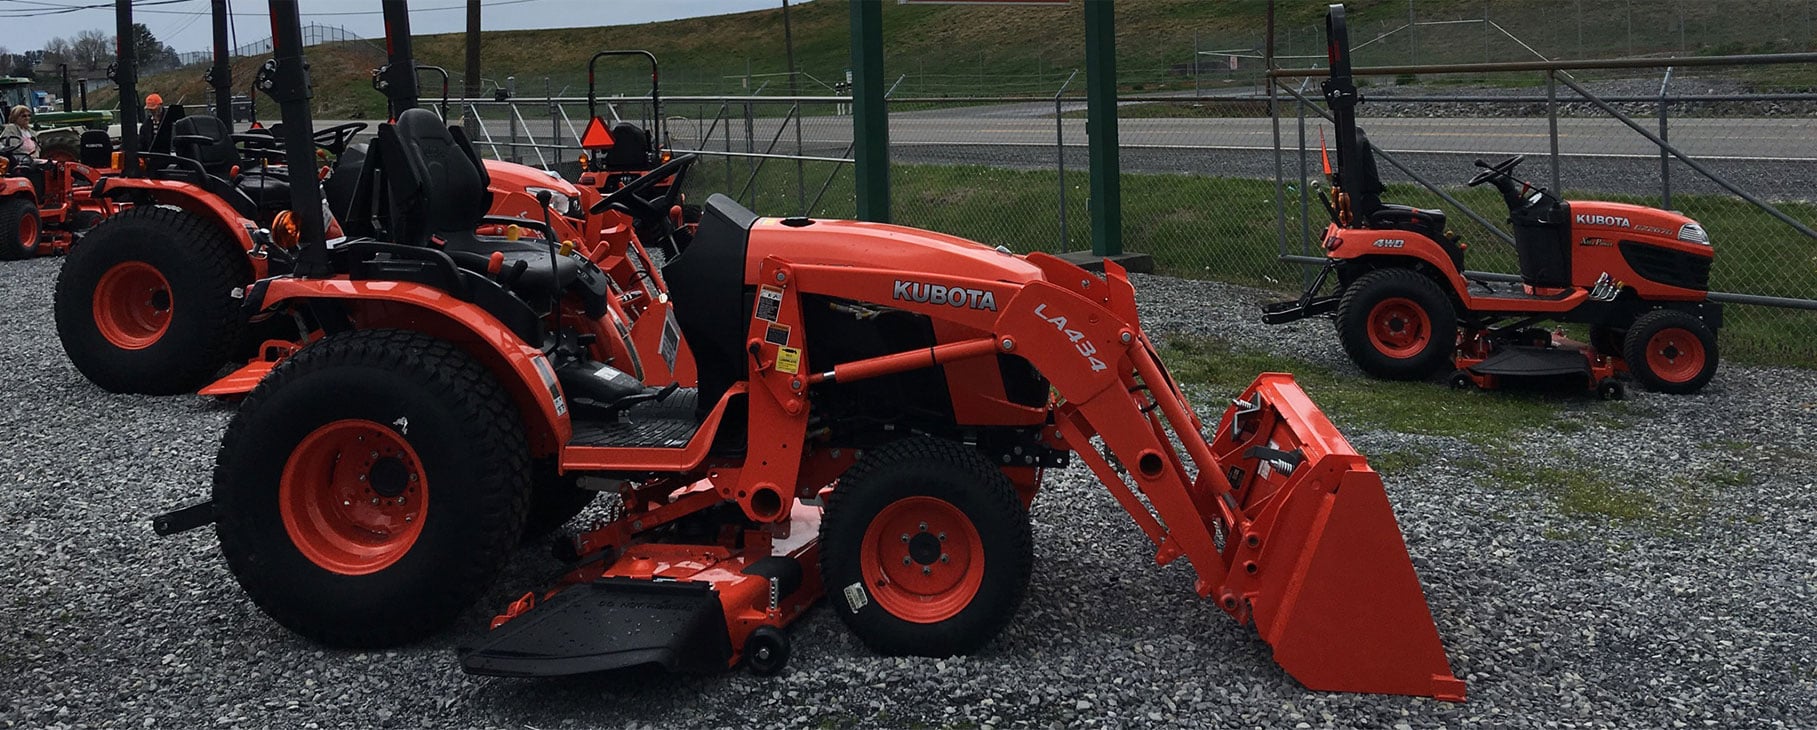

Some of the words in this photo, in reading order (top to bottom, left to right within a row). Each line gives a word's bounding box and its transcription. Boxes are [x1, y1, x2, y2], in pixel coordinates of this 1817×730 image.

[1575, 214, 1631, 228] KUBOTA
[1372, 238, 1405, 248] 4WD
[893, 280, 998, 312] KUBOTA
[1033, 303, 1108, 373] LA434
